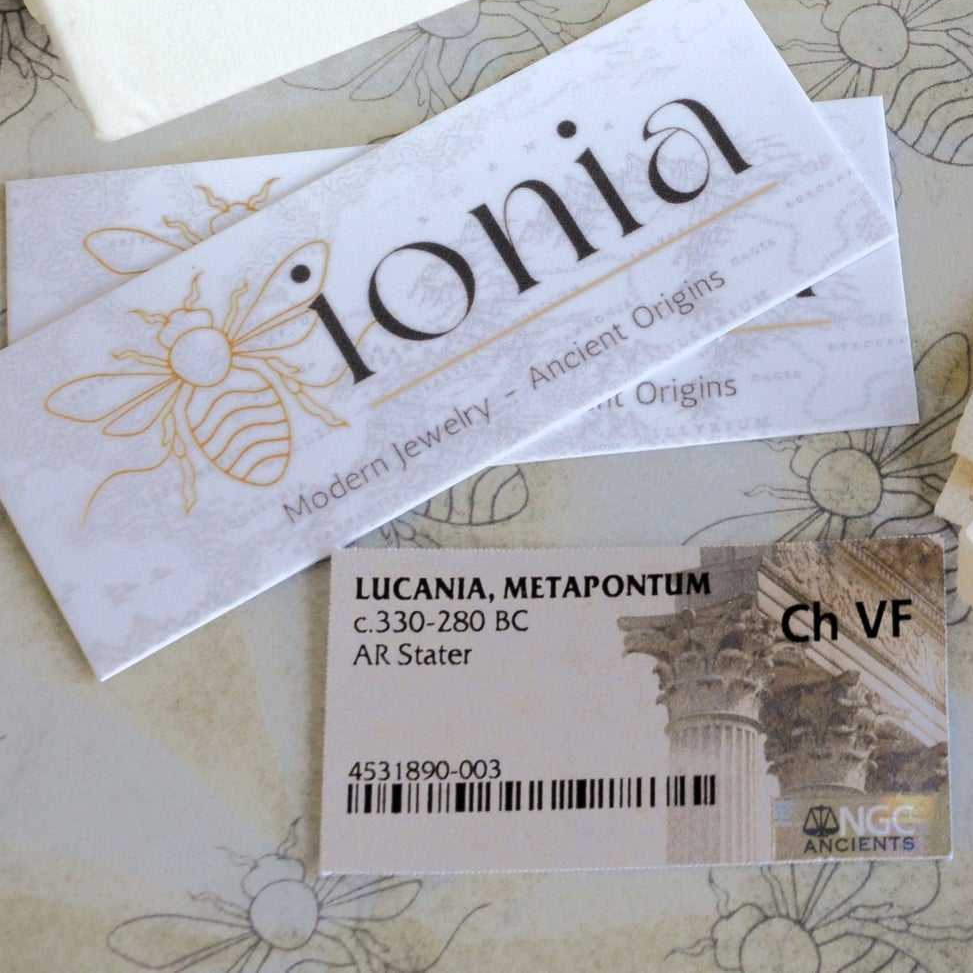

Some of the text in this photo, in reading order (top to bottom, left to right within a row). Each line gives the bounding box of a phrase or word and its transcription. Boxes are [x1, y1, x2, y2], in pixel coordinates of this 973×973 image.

[290, 98, 752, 384] ionia
[282, 472, 390, 524] Modern
[393, 397, 492, 470] Jewelry
[530, 322, 629, 390] Ancient
[631, 270, 726, 330] Origins
[635, 375, 737, 408] Origins
[355, 571, 712, 603] LUCANIA, METAPONTUM
[353, 609, 530, 634] c.330-280 BC
[781, 598, 914, 644] Ch VF
[353, 642, 473, 667] AR Stater
[348, 758, 502, 782] 4531890-003
[839, 804, 915, 836] NGC
[803, 835, 916, 855] ANCIENTS
